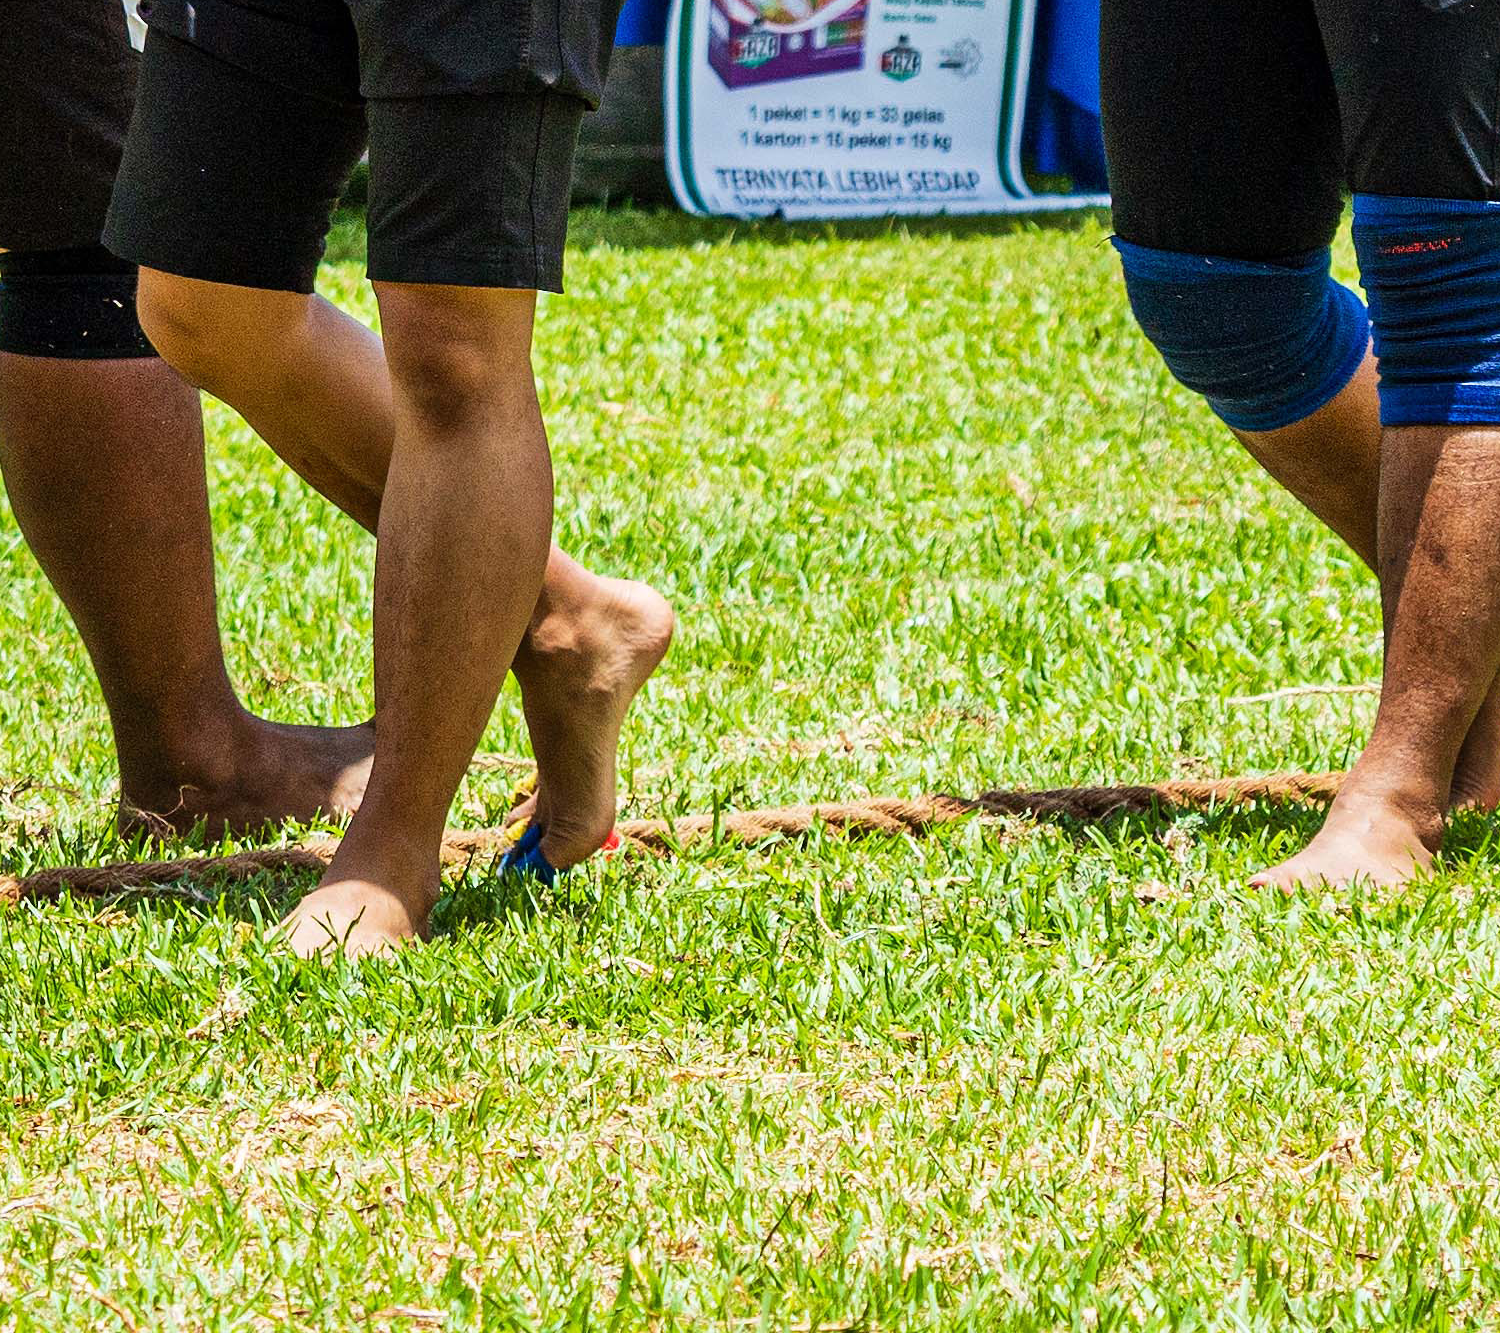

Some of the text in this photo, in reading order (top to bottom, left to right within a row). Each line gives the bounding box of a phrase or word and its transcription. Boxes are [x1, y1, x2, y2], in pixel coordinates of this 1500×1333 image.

[841, 105, 862, 126] kg
[932, 133, 953, 152] kg
[715, 168, 981, 192] TERNYATA LEBIH SEDAP
